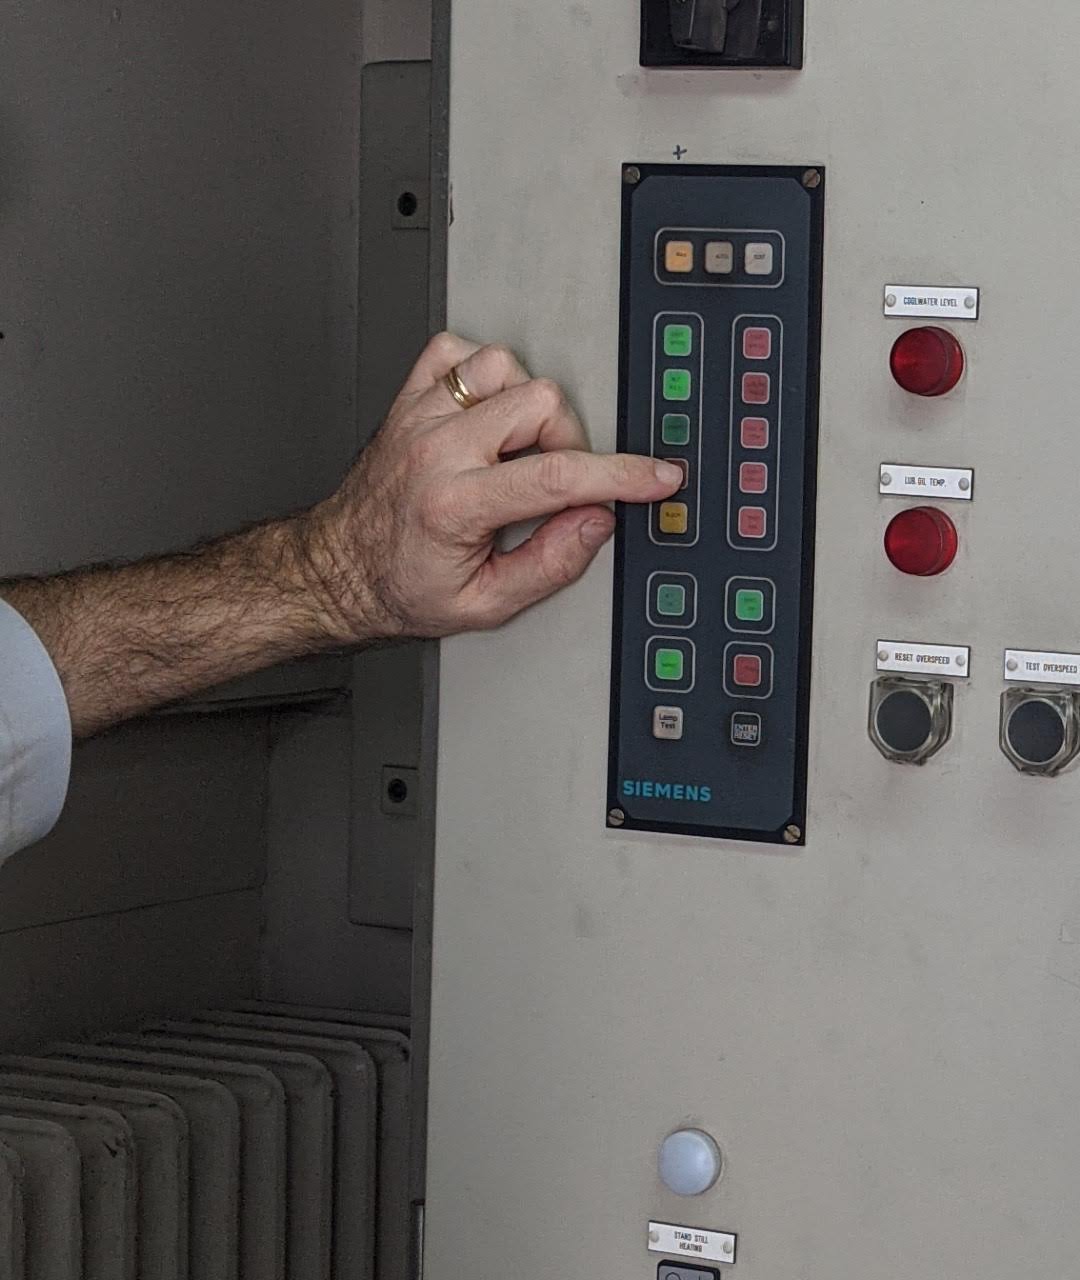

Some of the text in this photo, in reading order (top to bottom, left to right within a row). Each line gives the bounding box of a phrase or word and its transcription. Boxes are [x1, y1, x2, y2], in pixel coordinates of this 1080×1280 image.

[895, 652, 950, 664] RESET OVERSPEED
[1026, 662, 1077, 673] TEST OVERSPEED
[623, 780, 712, 802] SIEMENS
